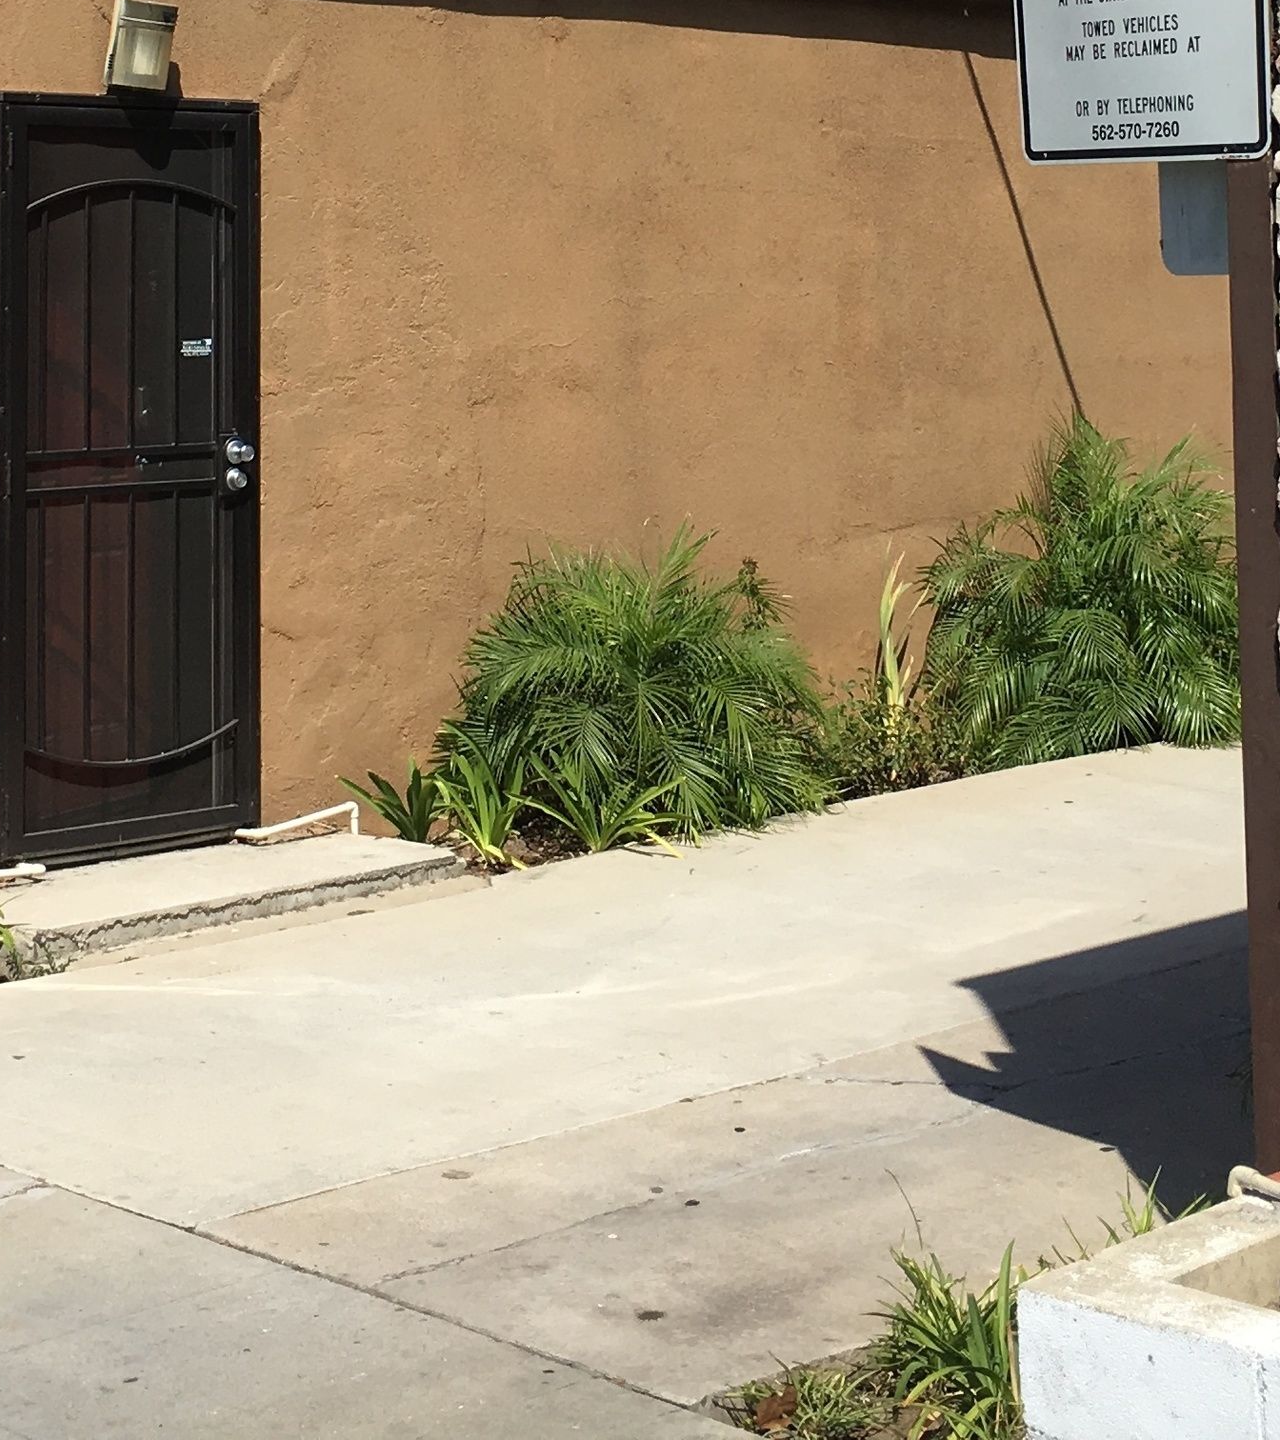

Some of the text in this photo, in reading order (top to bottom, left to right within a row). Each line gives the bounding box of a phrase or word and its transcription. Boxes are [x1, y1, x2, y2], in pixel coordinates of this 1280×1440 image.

[1081, 13, 1179, 38] TOWED VEHICLES
[1065, 35, 1201, 62] MAY BE RECLAIMED AT
[1075, 94, 1195, 117] OR BY TELEPHONING
[1091, 120, 1180, 141] 562-570-7260
